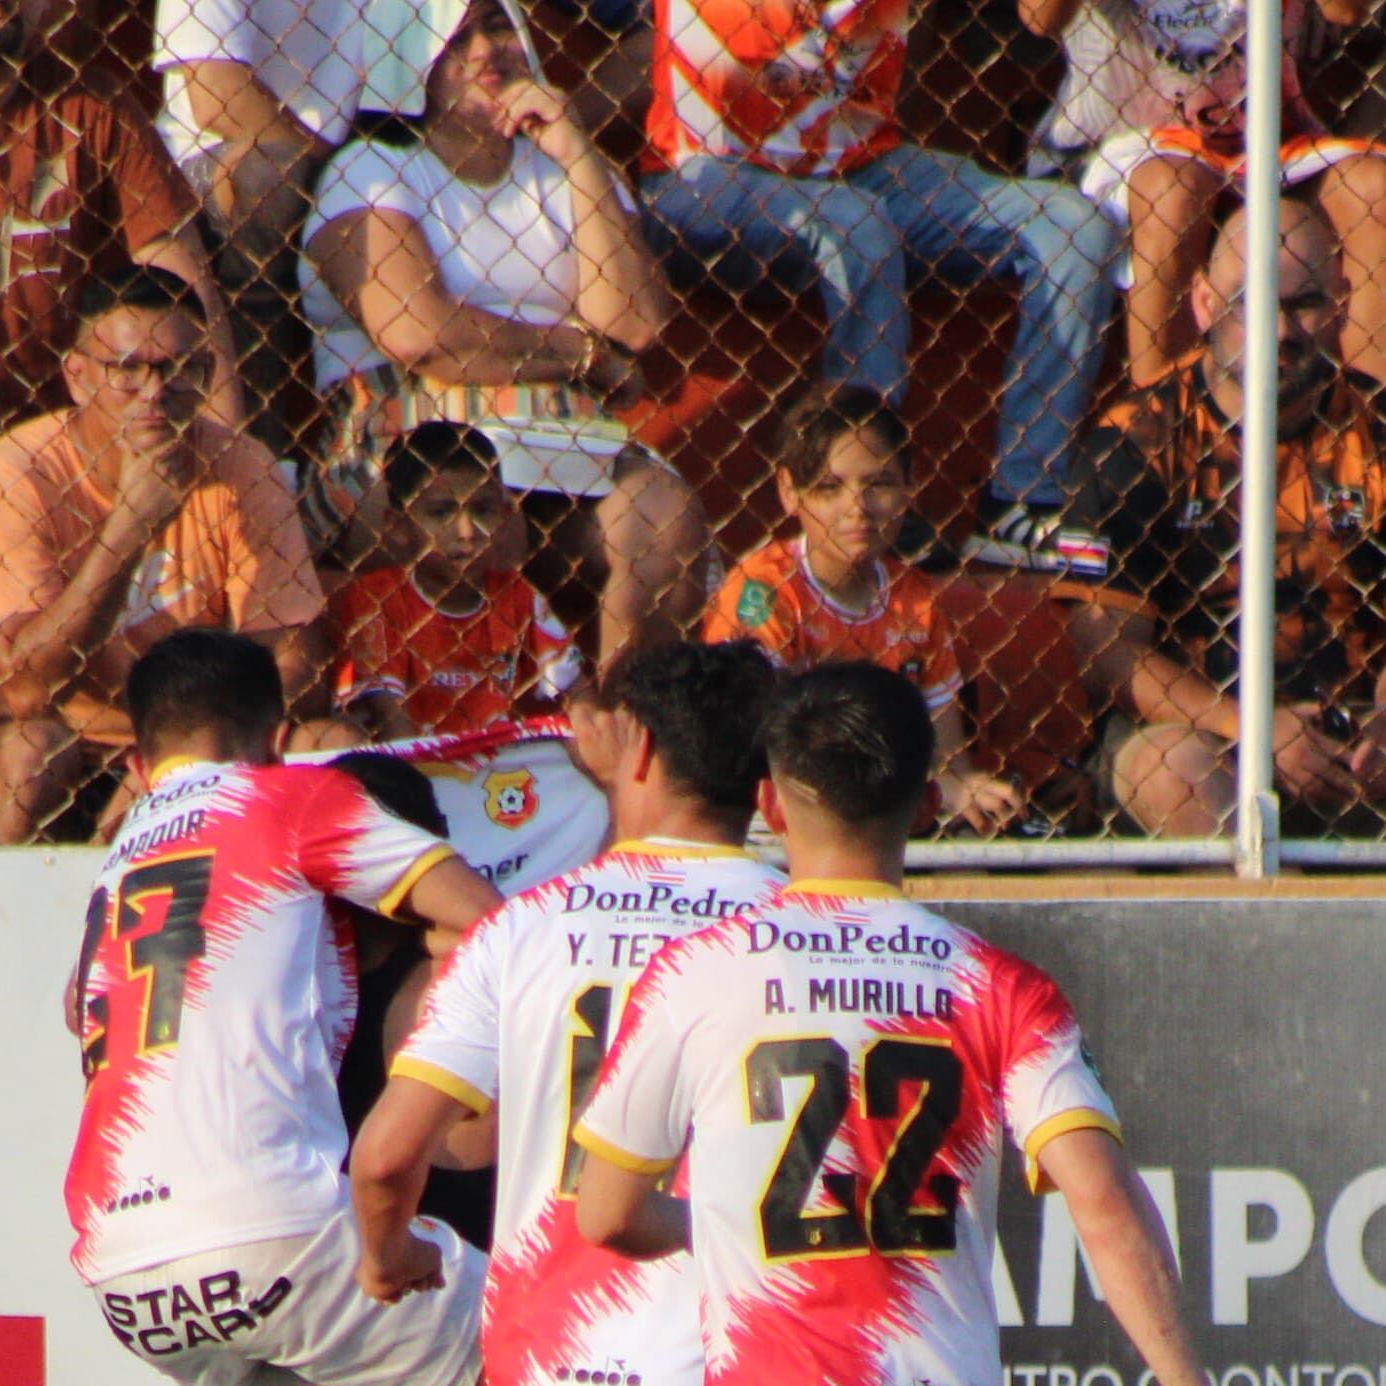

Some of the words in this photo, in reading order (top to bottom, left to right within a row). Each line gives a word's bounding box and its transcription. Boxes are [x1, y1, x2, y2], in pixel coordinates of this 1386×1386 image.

[132, 774, 221, 819] Pedro
[568, 933, 593, 967] Y.
[748, 921, 951, 961] DonPedro
[765, 978, 796, 1015] A.
[809, 977, 953, 1021] MURILLO
[739, 1033, 963, 1264] 22
[104, 1270, 242, 1328] STAR
